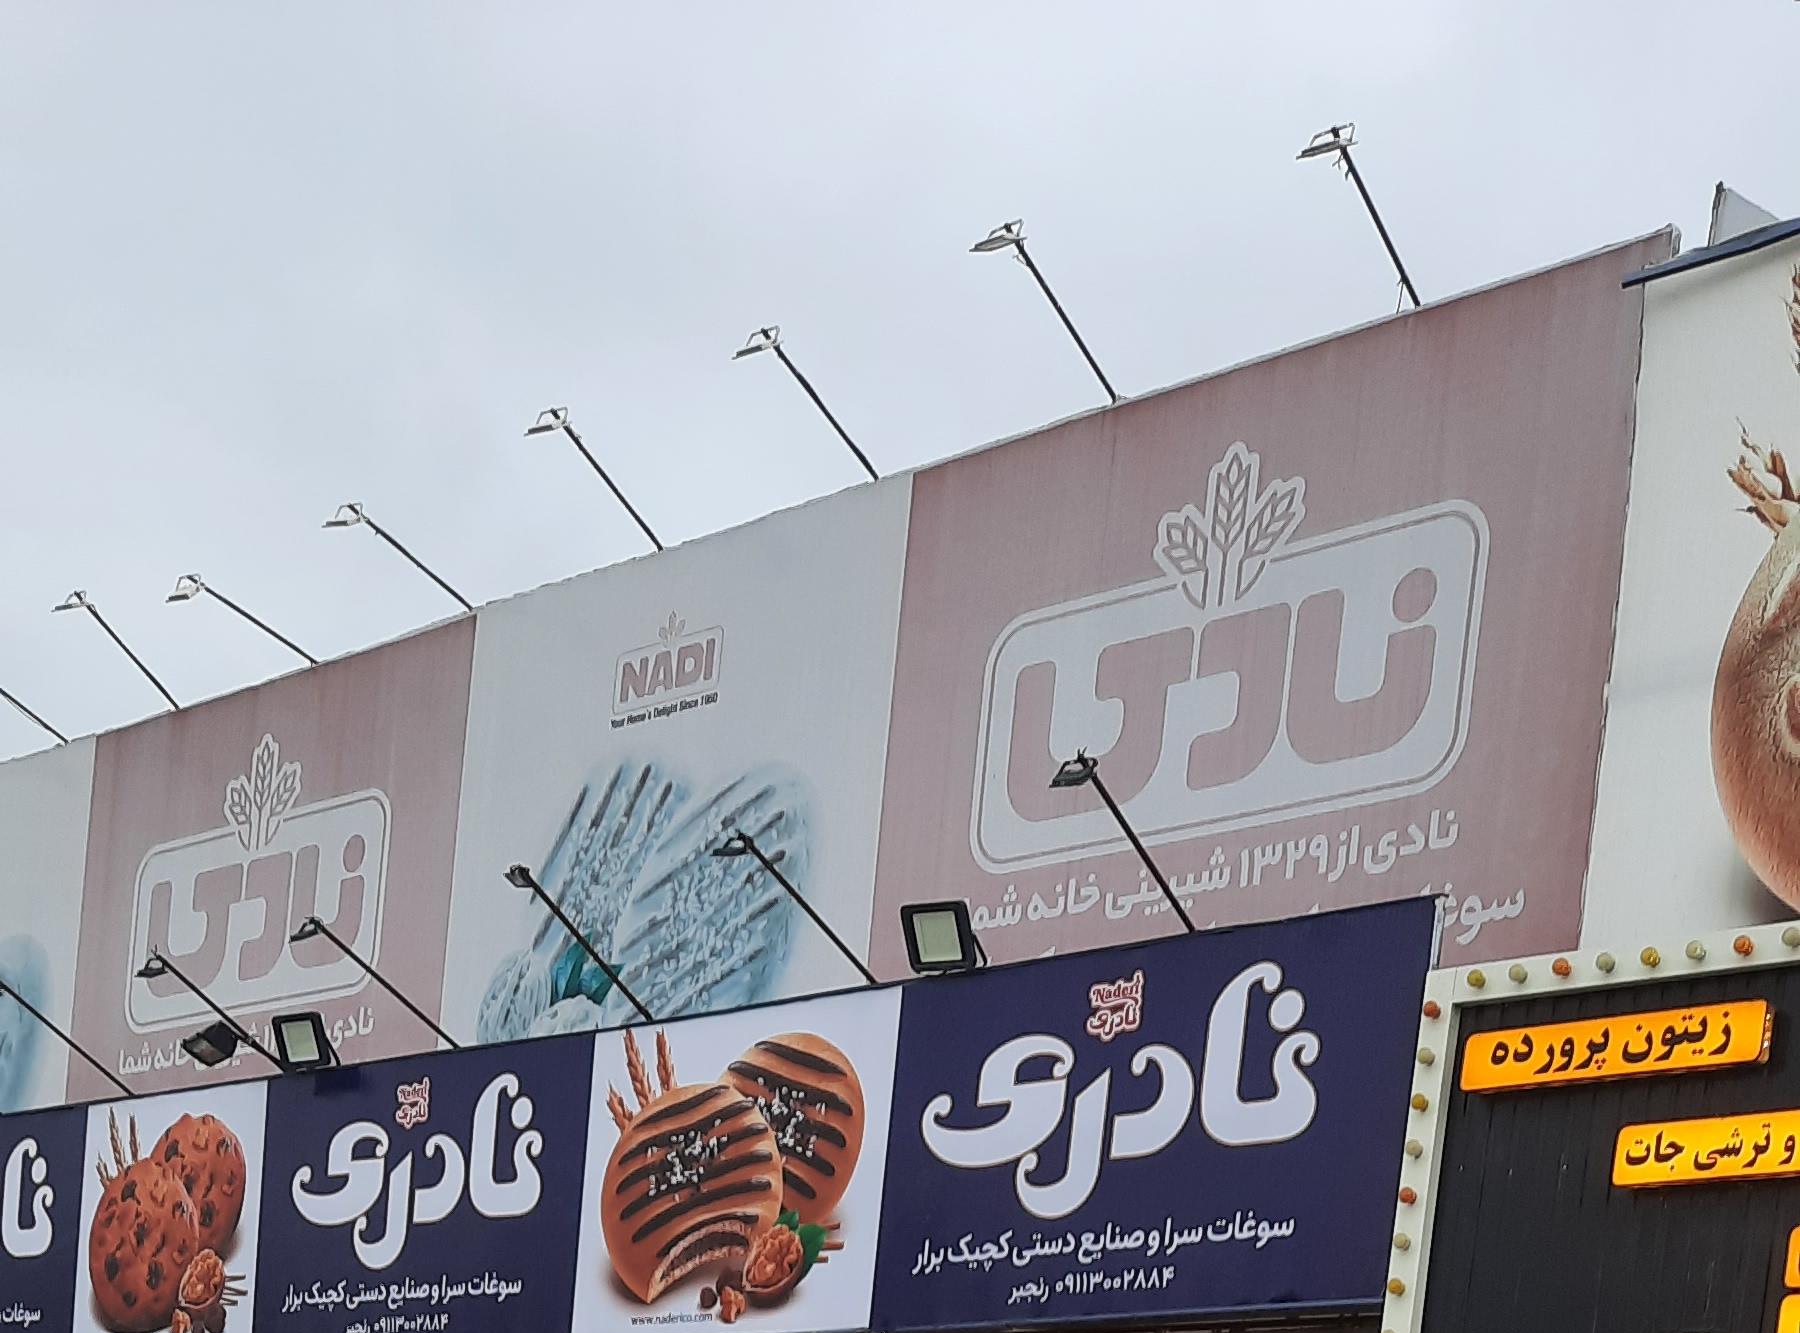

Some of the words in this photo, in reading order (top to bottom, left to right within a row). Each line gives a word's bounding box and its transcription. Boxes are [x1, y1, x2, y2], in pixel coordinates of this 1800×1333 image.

[619, 637, 716, 704] NADI
[1006, 567, 1439, 823] نادی
[1239, 834, 1330, 890] ۱۳۲۹
[1327, 824, 1360, 881] از
[1364, 808, 1460, 875] نادی
[1027, 872, 1102, 922] خانه
[1105, 847, 1231, 918] شیرینی
[146, 834, 366, 997] نادی
[966, 884, 1023, 931] شم
[1490, 1026, 1610, 1075] پرورده
[1622, 1009, 1732, 1064] زیتون
[118, 1042, 151, 1075] شما
[921, 960, 1321, 1221] نادری
[1625, 1130, 1686, 1172] جات
[1694, 1123, 1771, 1172] ترشی
[1778, 1132, 1796, 1166] و
[292, 1072, 544, 1271] نادری
[948, 1229, 1014, 1272] کچیک
[1012, 1232, 1075, 1266] دستی
[1078, 1223, 1144, 1263] صنایع
[1147, 1234, 1161, 1256] و
[1165, 1217, 1203, 1256] سرا
[1206, 1210, 1295, 1249] سوغات
[912, 1239, 945, 1275] برار
[346, 1283, 386, 1310] دستی
[388, 1277, 431, 1310] صنایع
[430, 1285, 440, 1305] و
[442, 1275, 466, 1304] سرا
[468, 1271, 523, 1302] سوغات
[1008, 1276, 1050, 1305] رنجبر
[2, 1302, 42, 1328] سوغات
